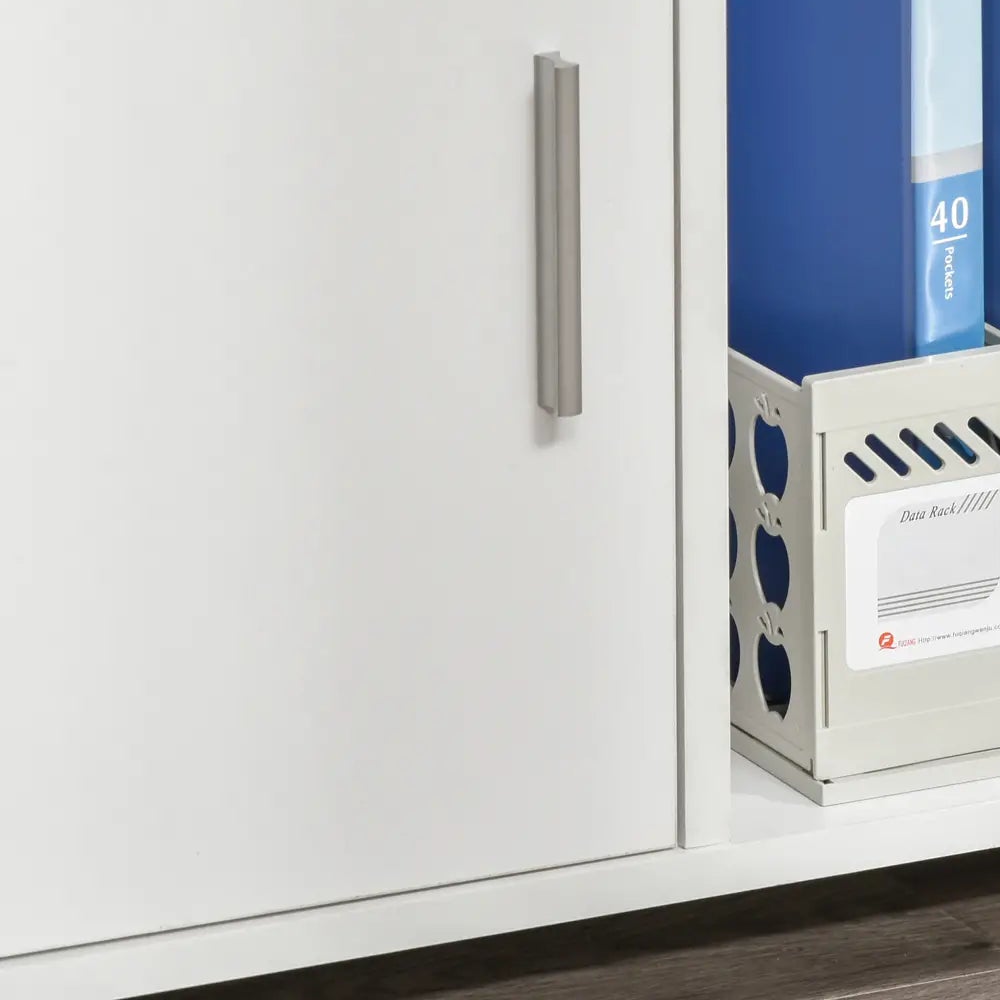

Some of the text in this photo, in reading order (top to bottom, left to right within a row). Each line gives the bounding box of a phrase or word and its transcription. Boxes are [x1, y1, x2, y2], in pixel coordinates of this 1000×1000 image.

[930, 196, 969, 233] 40
[944, 246, 955, 300] Pockets
[900, 502, 957, 523] Data Rack
